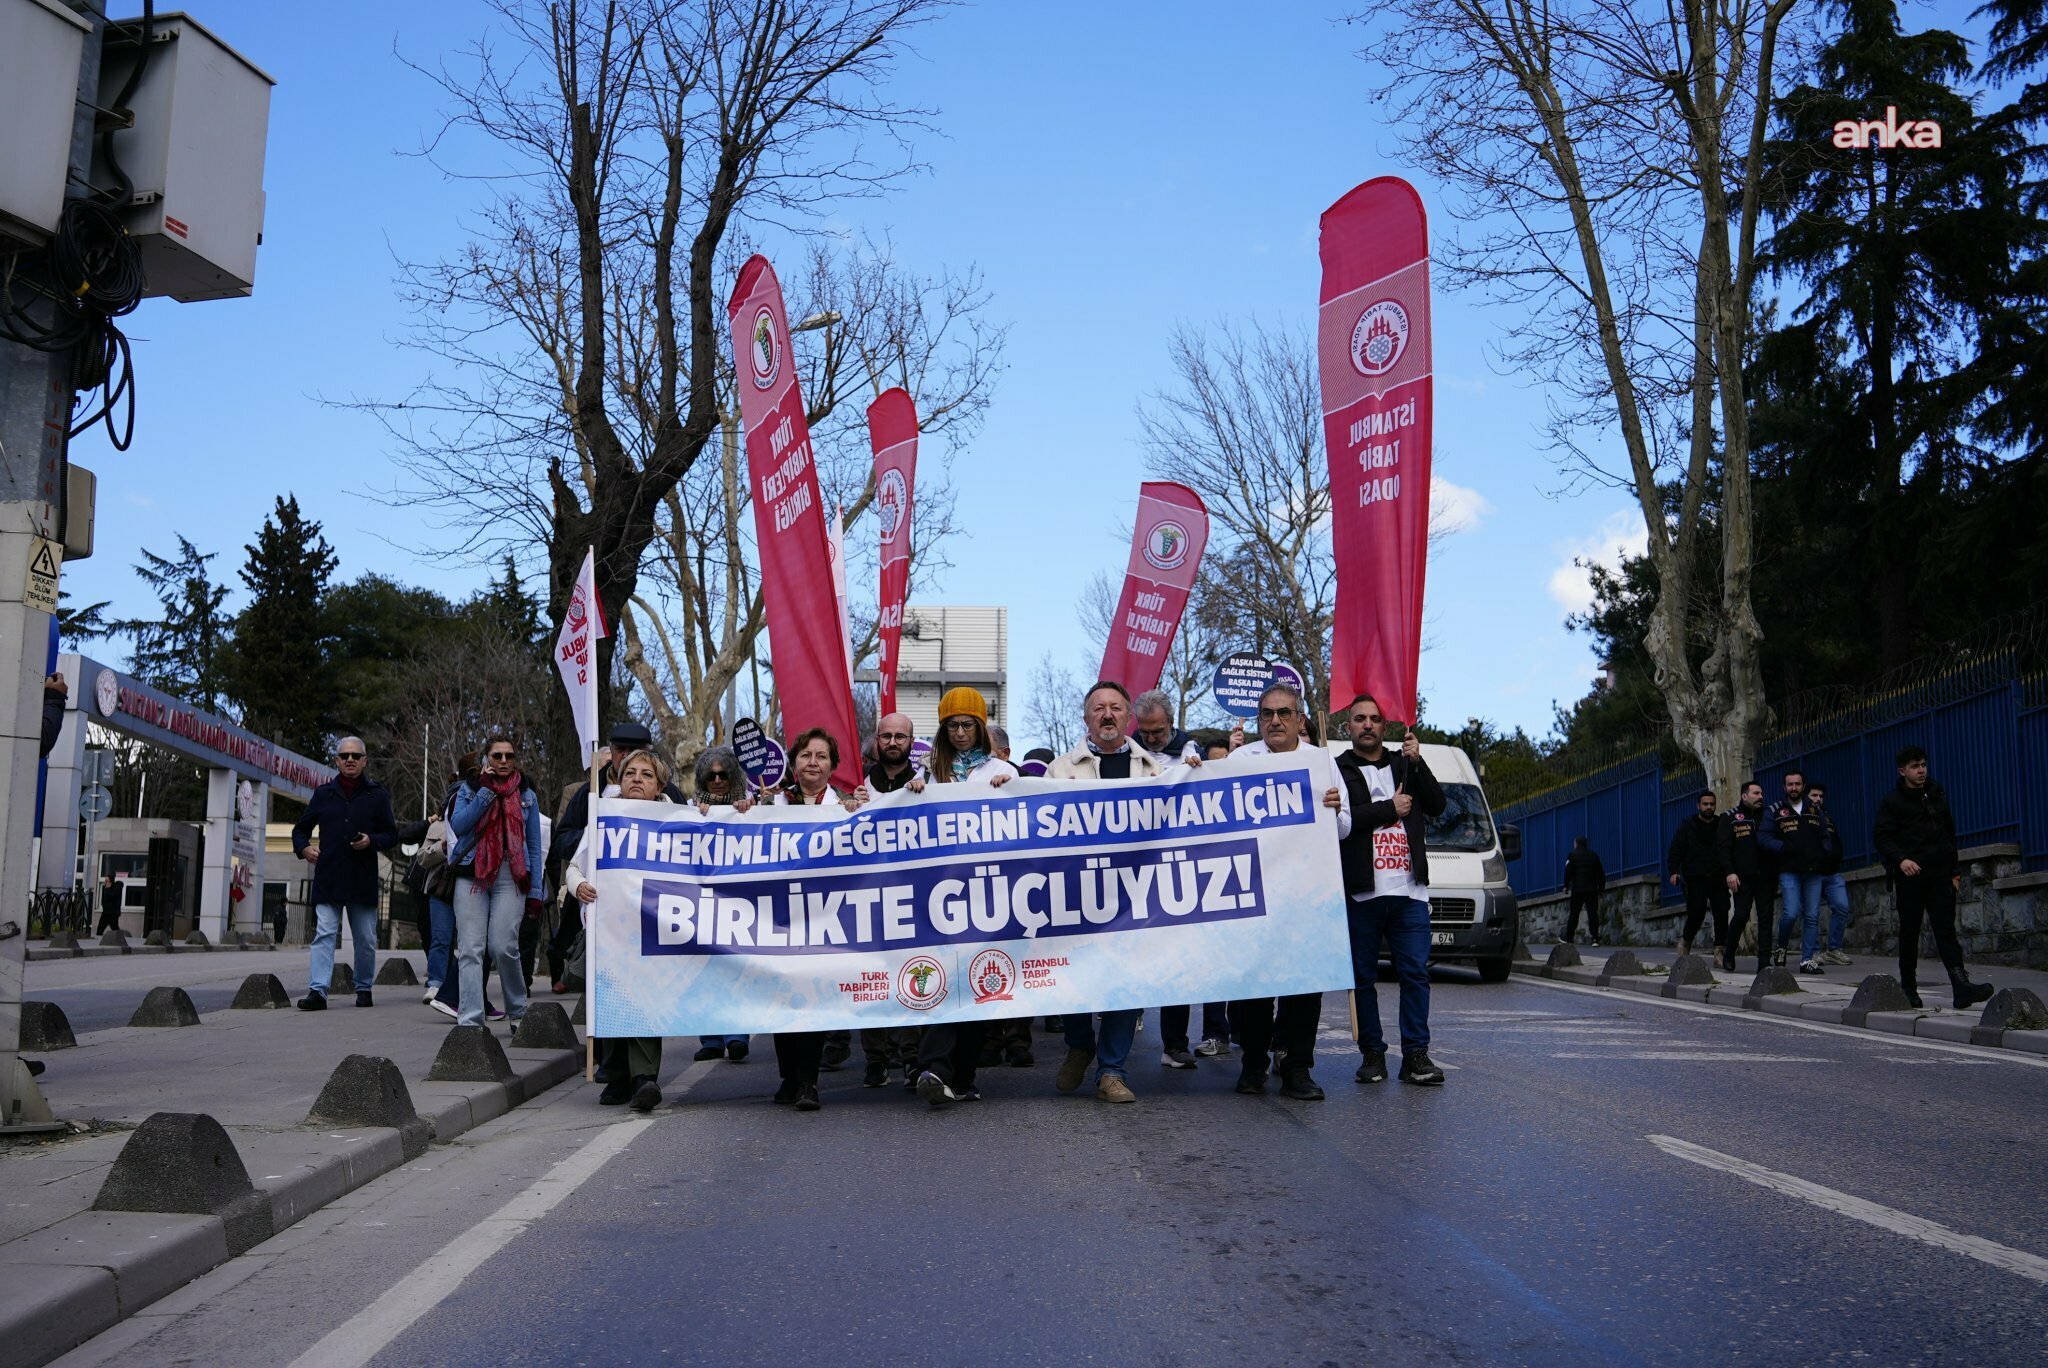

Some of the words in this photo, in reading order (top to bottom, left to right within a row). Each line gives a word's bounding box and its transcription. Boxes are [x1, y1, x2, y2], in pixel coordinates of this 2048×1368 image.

[35, 583, 51, 594] ÖLÜM
[27, 591, 55, 605] TEHLİKESİ
[1230, 658, 1253, 667] BAŞKA
[1254, 659, 1266, 668] BİR
[1221, 667, 1246, 677] SAĞLIK
[1246, 668, 1273, 679] SİSTEMİ
[1228, 678, 1252, 687] BAŞKA
[1252, 680, 1264, 688] BİR
[645, 827, 803, 866] HEKİMLİK
[808, 802, 1029, 858] DEĞERLERİNİ
[1036, 791, 1224, 838] SAVUNMAK
[1232, 778, 1304, 825] İÇİN
[657, 883, 916, 947] BİRLİKTE
[928, 851, 1256, 938] GÜÇLÜYÜZ!
[1021, 957, 1070, 969] İSTANBUL
[861, 971, 889, 981] TÜRK
[1022, 969, 1050, 979] TABİP
[839, 982, 889, 992] TABİPLERİ
[1023, 979, 1056, 989] ODASI
